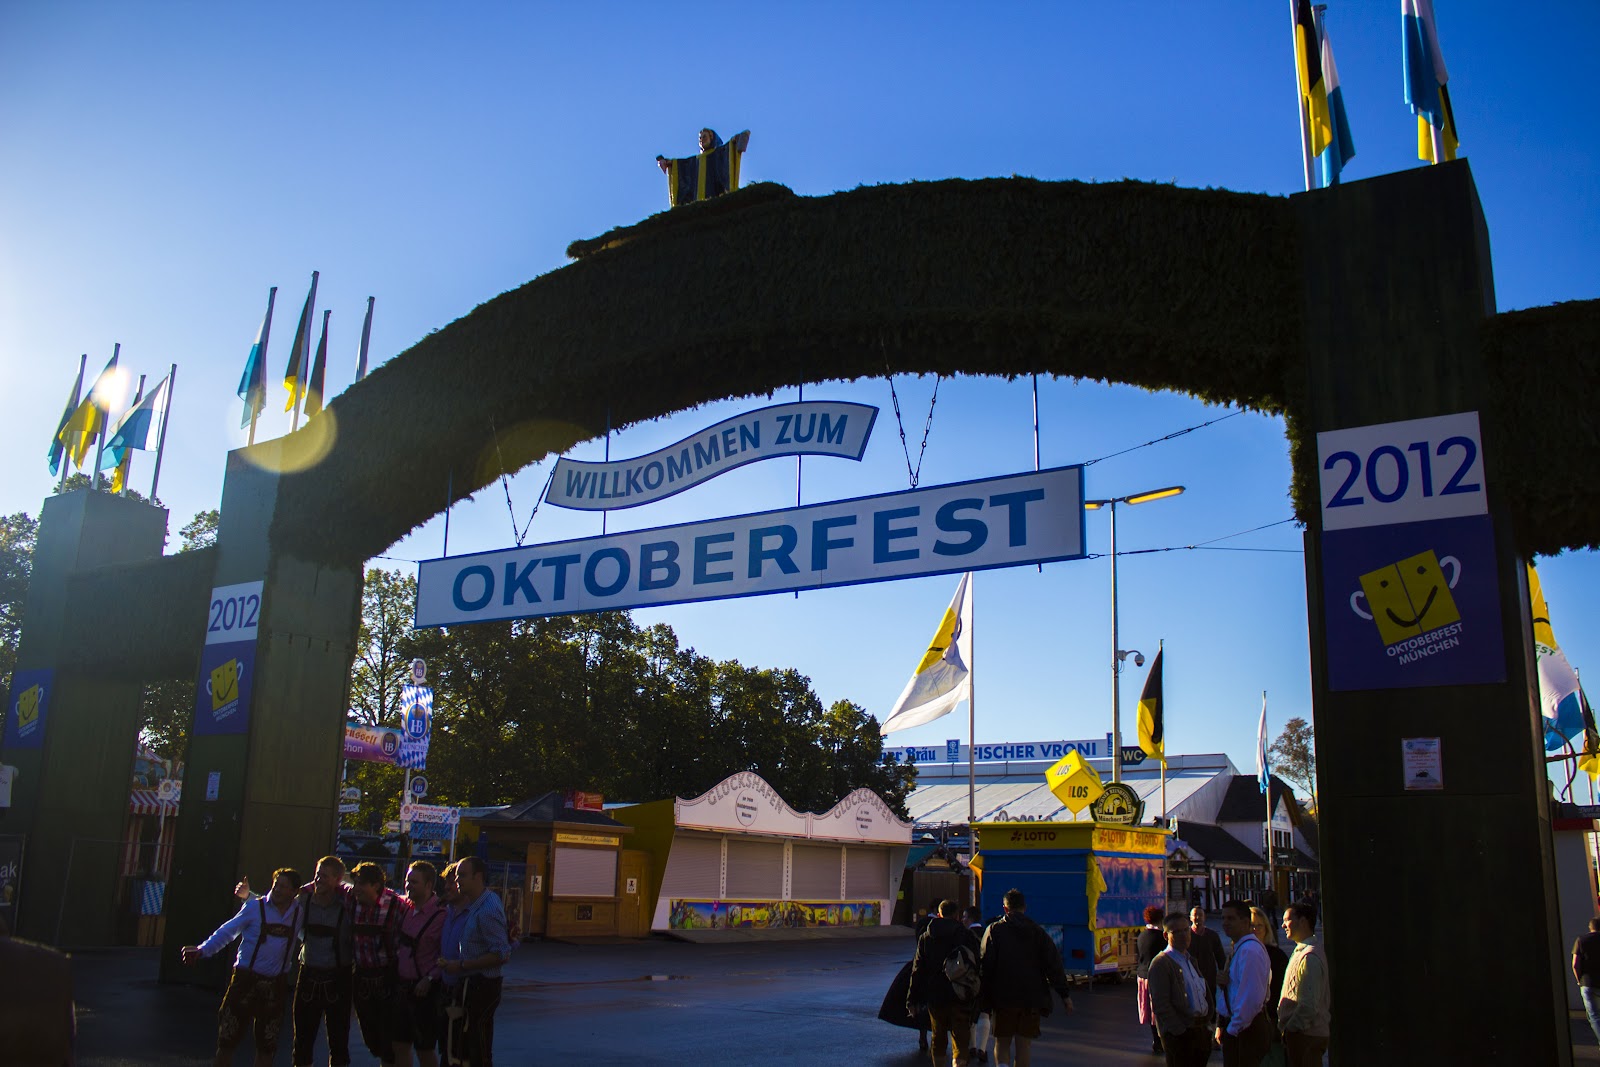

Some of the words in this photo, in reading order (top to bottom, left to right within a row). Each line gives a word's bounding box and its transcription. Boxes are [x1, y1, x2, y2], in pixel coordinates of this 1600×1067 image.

[565, 420, 761, 500] WILLKOMMEN
[774, 413, 849, 446] ZUM
[1323, 436, 1481, 509] 2012
[452, 488, 1045, 612] OKTOBERFEST
[208, 594, 260, 633] 2012
[1386, 622, 1463, 657] OKTOBERFEST
[1398, 637, 1460, 666] MÜNCHEN
[905, 747, 936, 763] Bräu
[1040, 742, 1097, 758] VRONI
[1122, 749, 1143, 761] WC
[1071, 785, 1089, 798] LOS
[418, 812, 443, 822] Eingang
[1024, 831, 1057, 841] LOTTO
[1107, 831, 1126, 844] LOTTO
